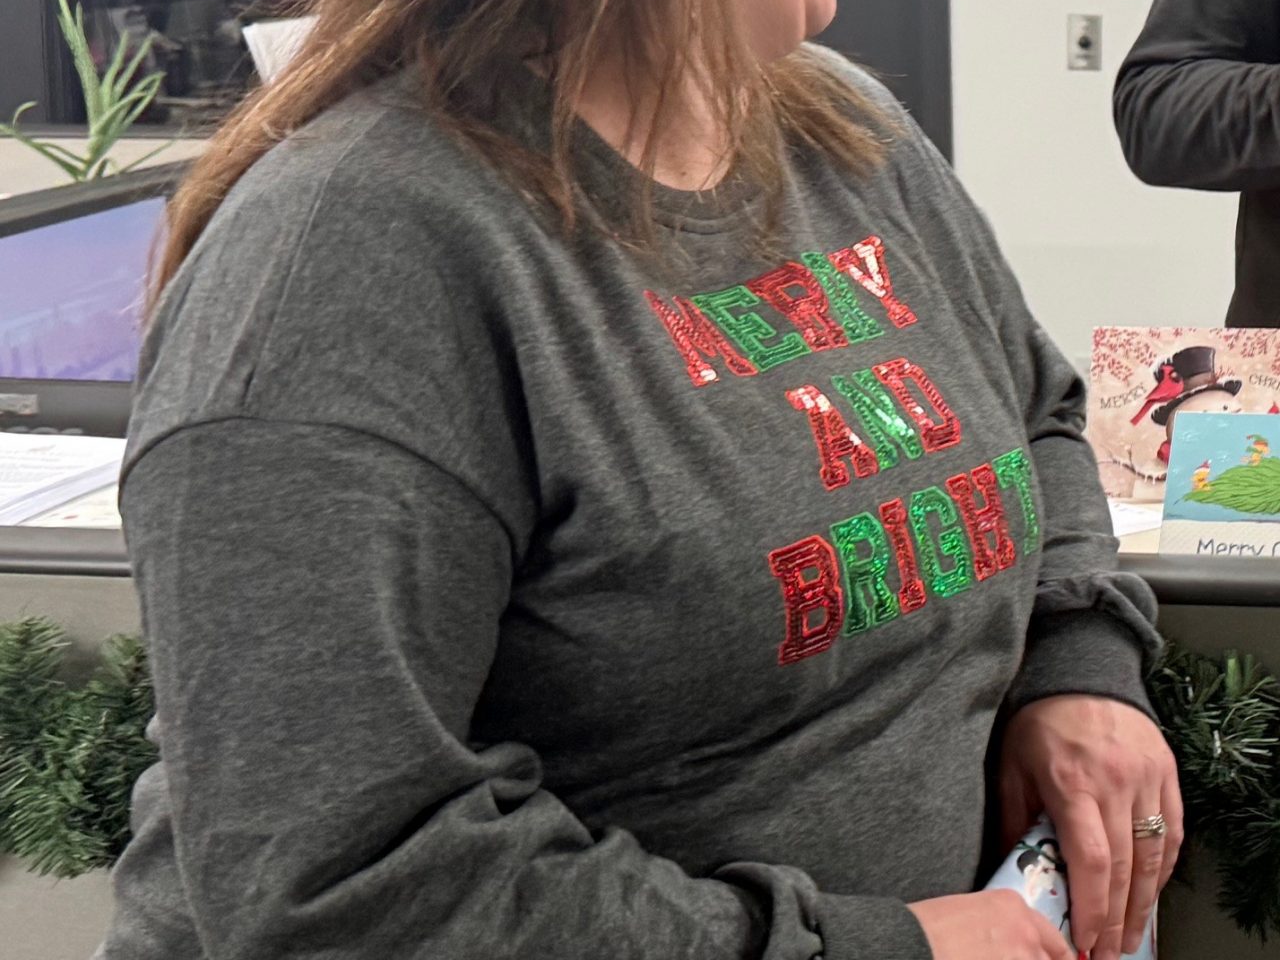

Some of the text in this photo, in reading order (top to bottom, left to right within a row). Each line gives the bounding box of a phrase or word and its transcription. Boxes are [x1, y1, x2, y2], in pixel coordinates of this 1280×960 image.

[785, 358, 961, 492] AND
[1099, 381, 1148, 410] MERRY
[768, 447, 1041, 667] BRIGHT
[1196, 538, 1267, 556] Merry
